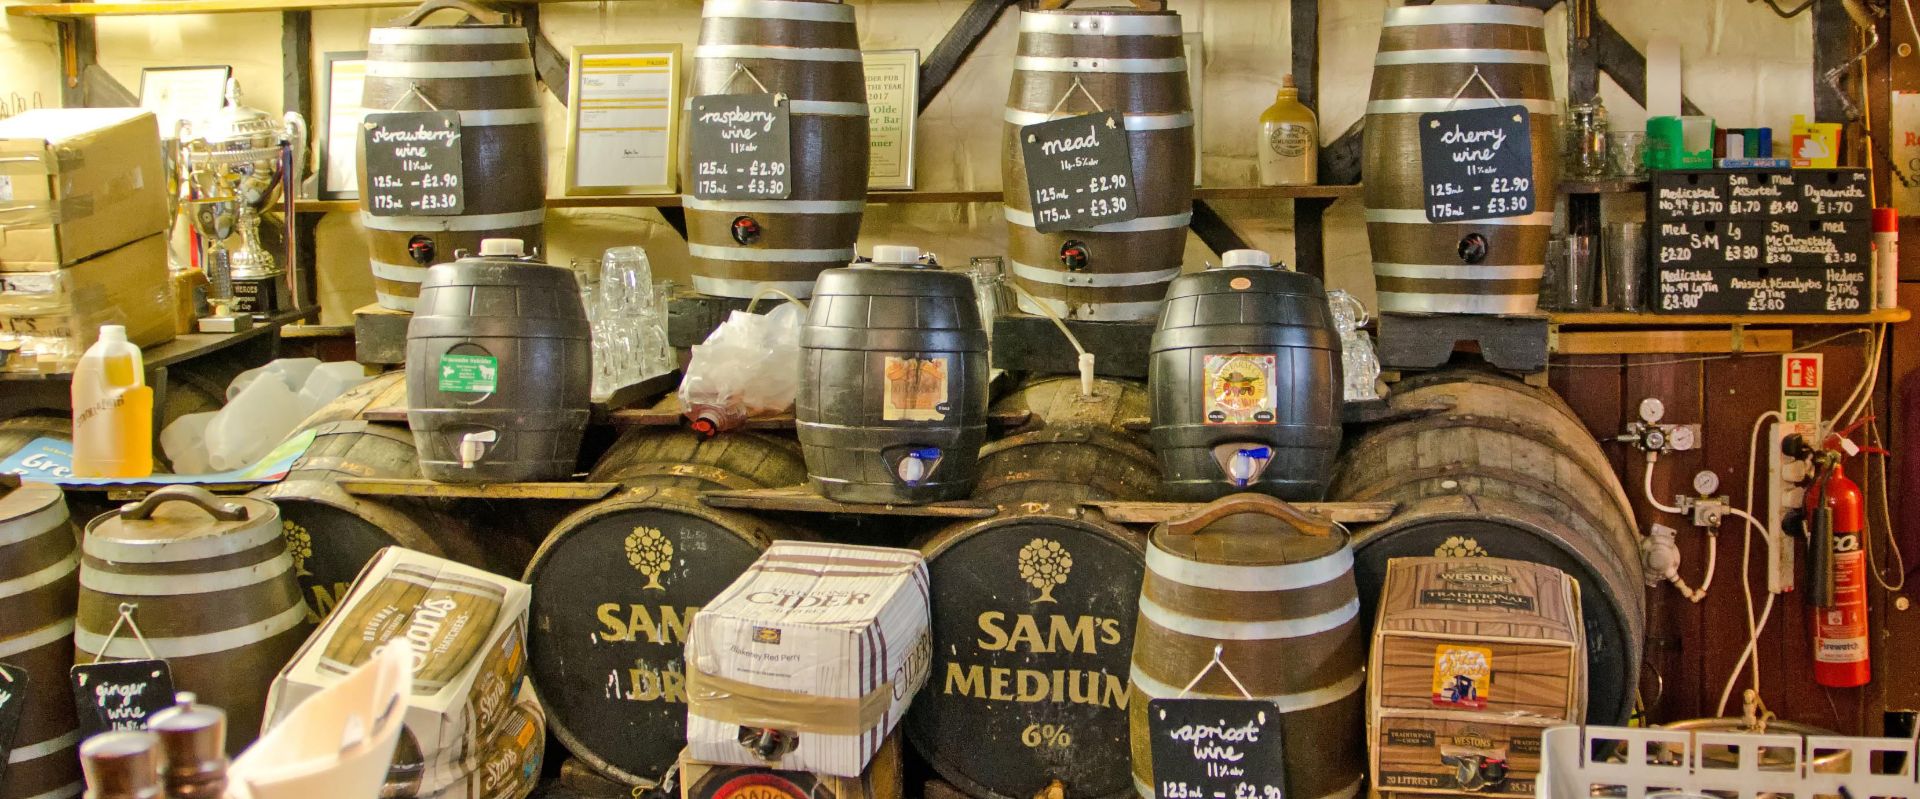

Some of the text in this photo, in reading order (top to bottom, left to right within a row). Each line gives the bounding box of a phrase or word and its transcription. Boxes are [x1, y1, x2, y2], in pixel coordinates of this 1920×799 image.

[868, 92, 889, 100] 2017
[874, 105, 897, 114] Olde
[699, 105, 776, 132] raspberry
[884, 116, 900, 124] Bar
[373, 124, 461, 147] strawberry
[722, 125, 757, 140] wine
[1042, 125, 1100, 155] mead
[1440, 123, 1507, 150] cherry
[396, 143, 427, 157] wine
[1453, 147, 1496, 162] wine
[699, 162, 728, 175] 125ml
[749, 160, 785, 176] £2.90
[374, 175, 403, 187] 125ml
[422, 173, 458, 188] £2.90
[699, 180, 727, 194] 175ml
[748, 178, 783, 194] £3.30
[1431, 183, 1464, 196] 125ml
[1491, 177, 1529, 193] £2.90
[1729, 174, 1794, 185] Sm Med
[1036, 187, 1069, 204] 125ml
[1089, 174, 1126, 193] £2.90
[1659, 187, 1720, 199] Medicated
[1732, 185, 1782, 196] Assorted
[1804, 184, 1866, 203] Dynamite
[375, 194, 403, 209] 175ml
[422, 194, 456, 210] £3.30
[1039, 207, 1072, 223] 175ml
[1090, 197, 1127, 217] £3.30
[1432, 203, 1464, 217] 175ml
[1488, 196, 1527, 213] £3.30
[1729, 200, 1761, 215] £1.70
[1662, 223, 1690, 236] Med
[1728, 222, 1741, 240] Lg
[1771, 221, 1846, 233] Sm Med
[1661, 269, 1714, 282] Medicated
[1826, 268, 1864, 285] Hedges
[1748, 298, 1784, 311] £3.80
[21, 453, 74, 478] Gre
[1441, 572, 1514, 584] WESTONS
[746, 591, 871, 609] CIDER
[1427, 591, 1528, 604] TRADITIONAL
[363, 604, 399, 641] ORIGINAL
[596, 603, 701, 644] SAM
[764, 654, 779, 662] Red
[780, 654, 801, 663] Perry
[893, 631, 930, 701] CIDER
[626, 668, 688, 703] DR
[944, 662, 1132, 711] MEDIUM
[96, 682, 147, 706] ginger
[107, 704, 146, 720] wine
[1021, 723, 1071, 747] 6%
[1170, 719, 1259, 745] apricot
[1391, 731, 1432, 739] TRADITIONAL
[1453, 736, 1491, 747] WESTONS
[1512, 738, 1541, 747] TRADITI
[1193, 740, 1244, 761] wine
[1386, 776, 1397, 784] 20
[1397, 776, 1429, 785] LITRES
[1510, 783, 1528, 792] 35.2
[1163, 781, 1202, 798] 125ml
[1235, 782, 1281, 799] £2.90
